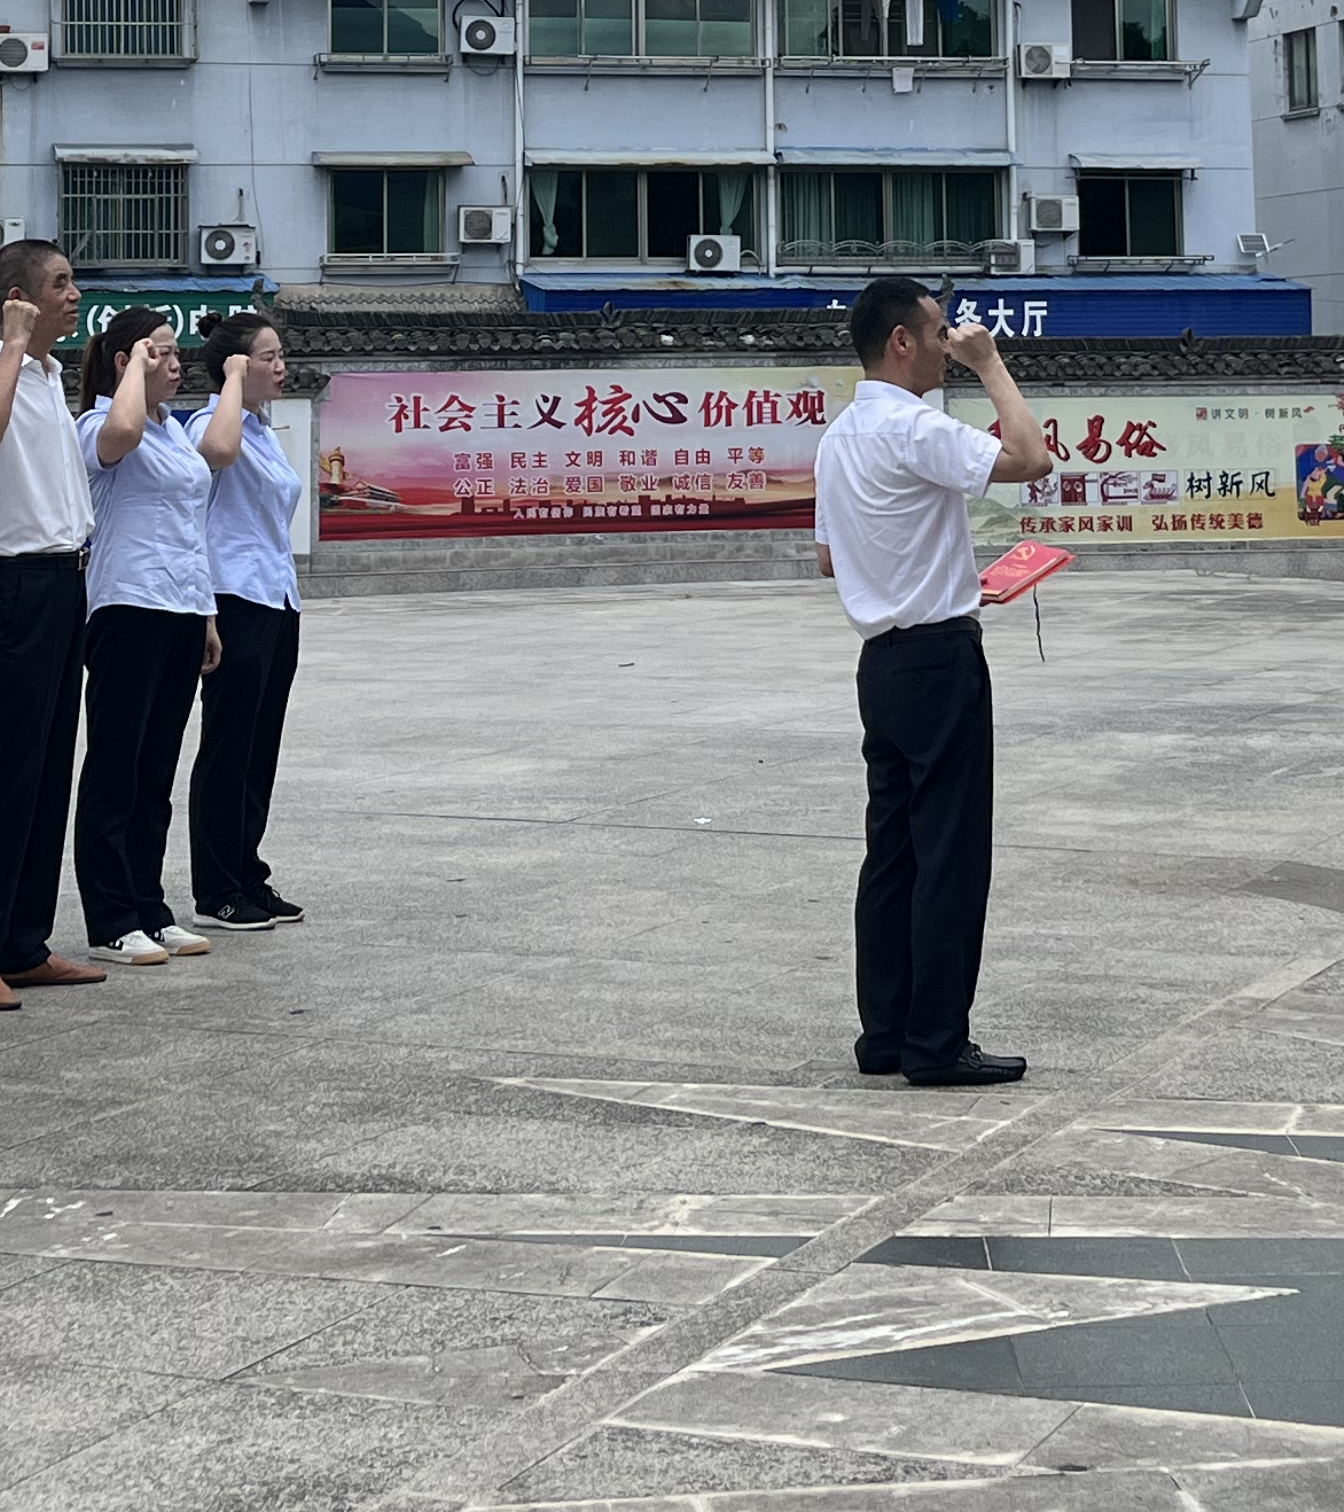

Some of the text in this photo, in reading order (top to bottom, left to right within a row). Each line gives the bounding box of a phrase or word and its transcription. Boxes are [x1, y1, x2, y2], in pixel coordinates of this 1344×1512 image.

[387, 385, 827, 437] 社会主义核心价值观
[987, 415, 1167, 464] 风易俗
[454, 447, 766, 470] 富强 民主 文明 和谐 自由 平等
[454, 471, 766, 496] 公正 法治 爱国 敬业 诚信 友善
[1185, 470, 1276, 499] 树新风
[1020, 512, 1265, 533] 传承家风家训 弘扬传统美德
